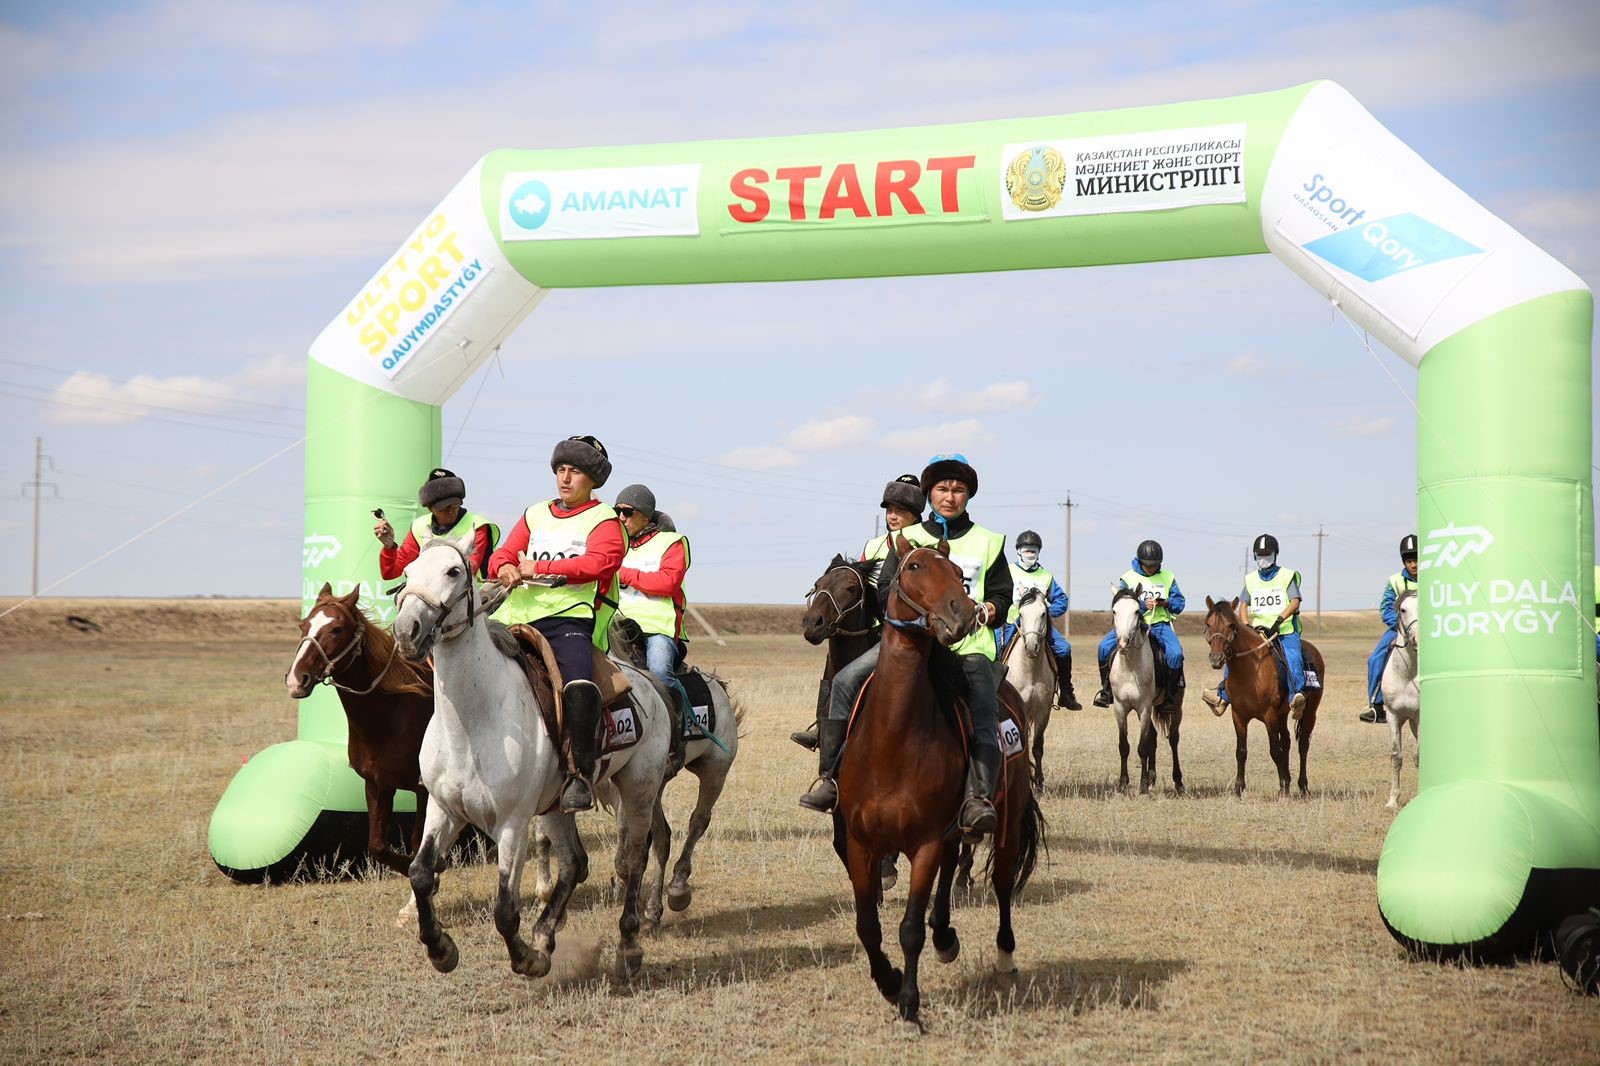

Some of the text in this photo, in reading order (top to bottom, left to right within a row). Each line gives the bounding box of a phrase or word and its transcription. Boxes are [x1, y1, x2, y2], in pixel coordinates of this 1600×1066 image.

[1075, 152, 1241, 176] МӘДЕНИЕТ ЖӘНЕ СПОРТ
[1076, 139, 1241, 162] ҚАЗАҚСТАН РЕСПУБЛИКАСЫ
[727, 155, 976, 223] START
[1075, 166, 1241, 197] МИНИСТРЛІГІ
[560, 186, 688, 213] AMANAT
[1303, 173, 1366, 226] Sport
[1362, 221, 1424, 271] Qory
[359, 231, 465, 357] SPORT
[1254, 595, 1281, 606] 1205
[1489, 578, 1578, 604] DALA
[1003, 728, 1019, 745] 05
